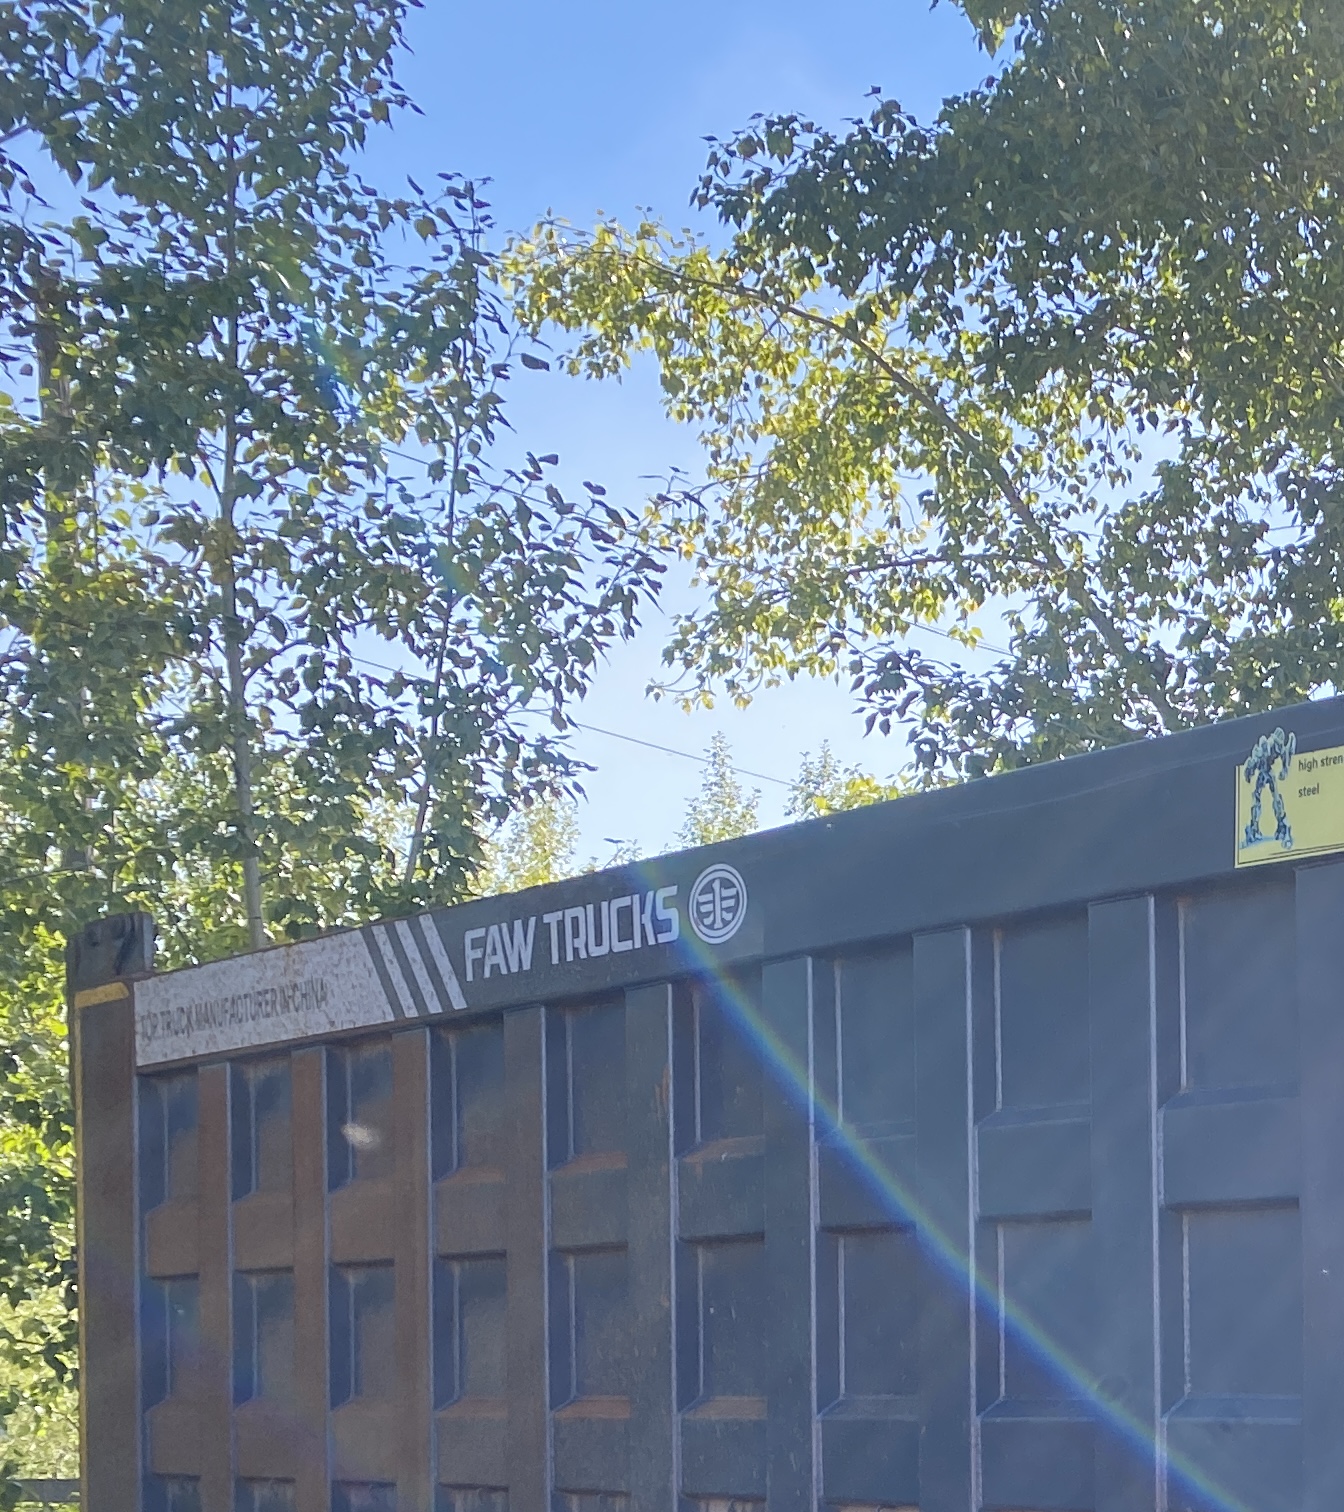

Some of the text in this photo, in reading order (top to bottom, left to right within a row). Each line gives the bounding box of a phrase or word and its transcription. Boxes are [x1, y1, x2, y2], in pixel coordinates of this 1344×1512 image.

[1298, 757, 1318, 772] high
[1298, 782, 1319, 798] steel
[464, 885, 680, 982] FAW TRUCKS
[194, 986, 278, 1032] MANUFACTURER
